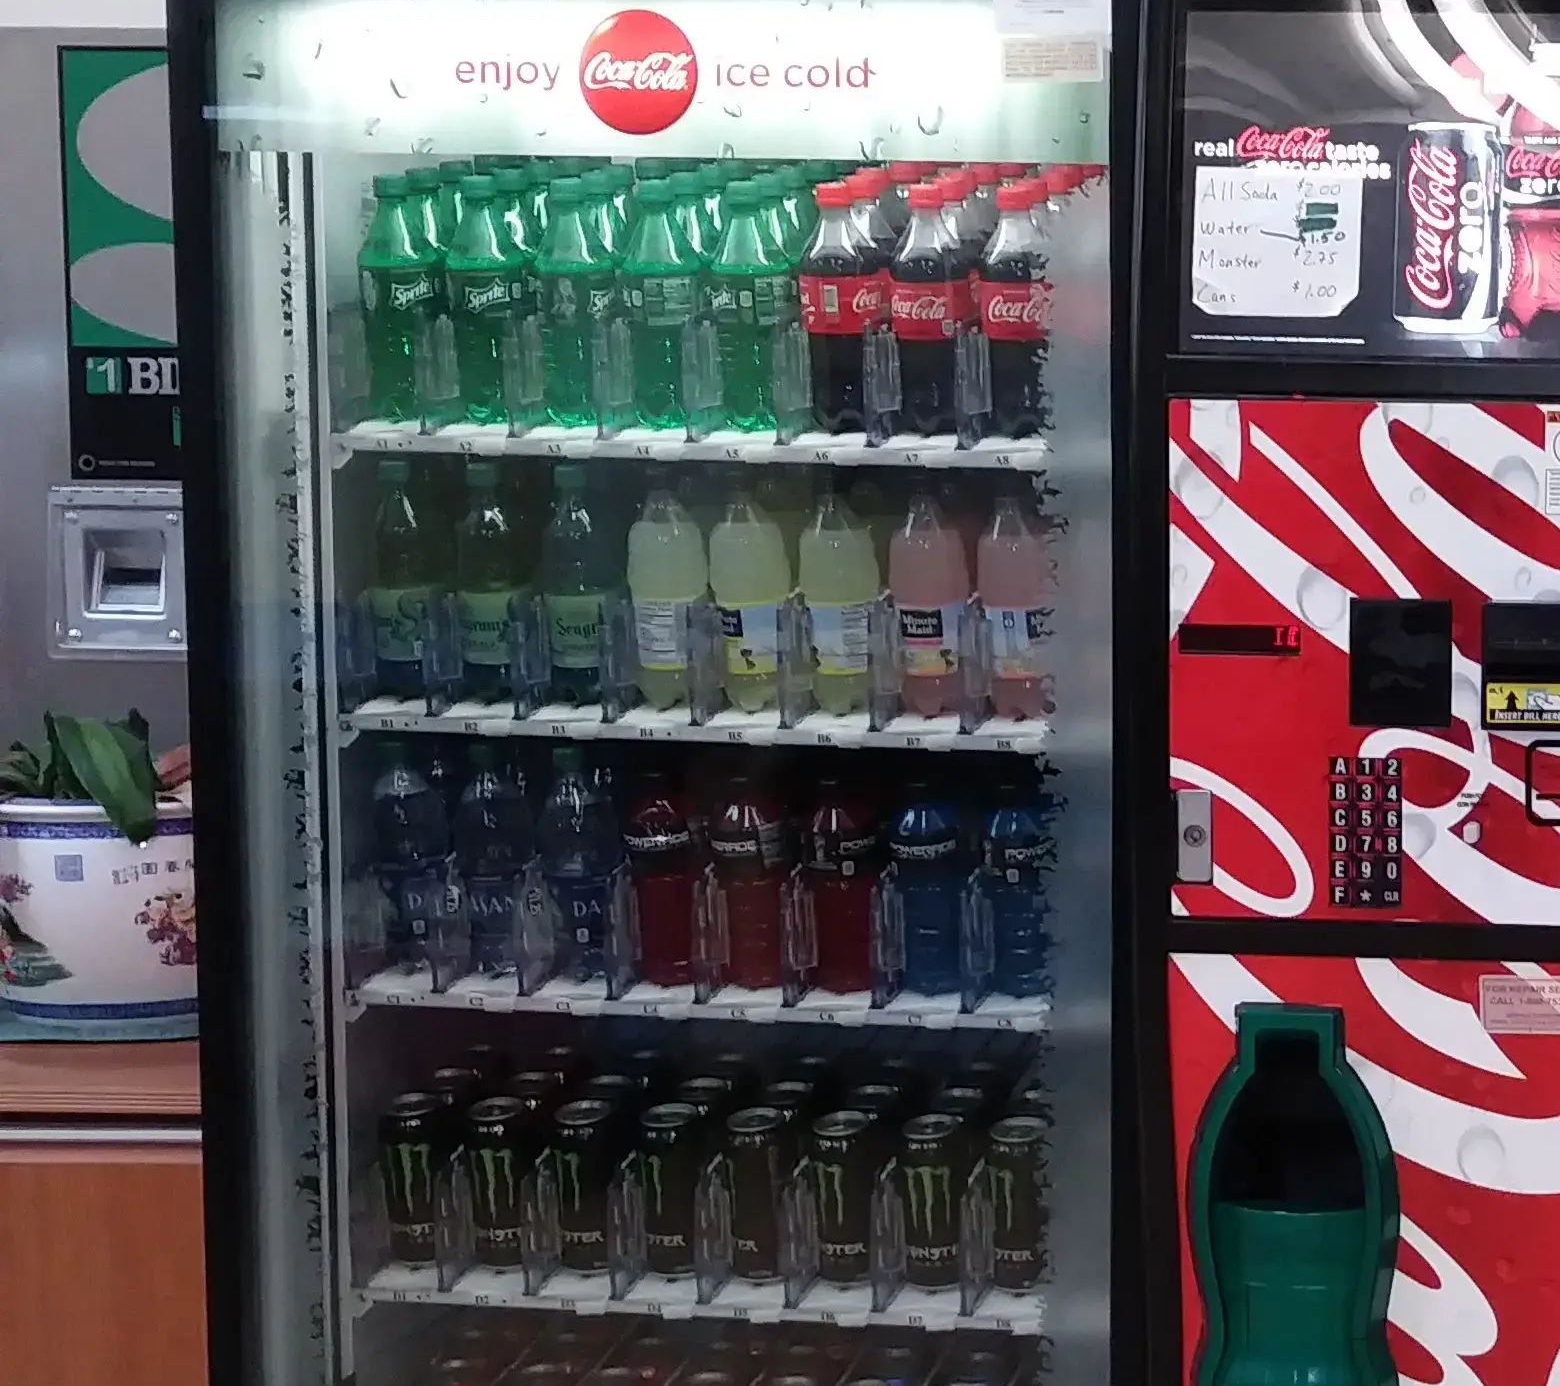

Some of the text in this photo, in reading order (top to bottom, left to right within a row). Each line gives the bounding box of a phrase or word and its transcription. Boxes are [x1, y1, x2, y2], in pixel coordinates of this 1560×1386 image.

[456, 57, 561, 91] enjoy
[716, 56, 770, 88] ice
[785, 56, 873, 89] cold
[1194, 138, 1234, 156] real
[1325, 142, 1380, 161] taste
[1201, 177, 1234, 203] All
[1240, 180, 1280, 202] Soda
[1200, 222, 1251, 236] Water
[1457, 181, 1484, 275] zero
[1199, 248, 1262, 269] Monster
[394, 275, 431, 307] Sprite
[467, 280, 508, 310] Sprite
[1196, 283, 1237, 303] Cans
[547, 444, 561, 454] A3
[635, 446, 649, 455] A4
[725, 449, 739, 458] A5
[815, 451, 829, 461] A6
[904, 454, 919, 463] A7
[994, 456, 1009, 465] A8
[903, 614, 938, 627] Minute
[1495, 709, 1521, 720] INSERT
[1524, 710, 1540, 720] BILL
[817, 734, 831, 743] B6
[907, 738, 920, 747] B7
[1335, 758, 1397, 775] A 1 2
[1335, 783, 1397, 801] B 3 4
[1335, 809, 1397, 827] C 5 6
[1335, 835, 1397, 853] D 7 8
[1335, 861, 1397, 879] E 9 0
[1335, 887, 1344, 903] F
[1490, 996, 1514, 1005] CALL
